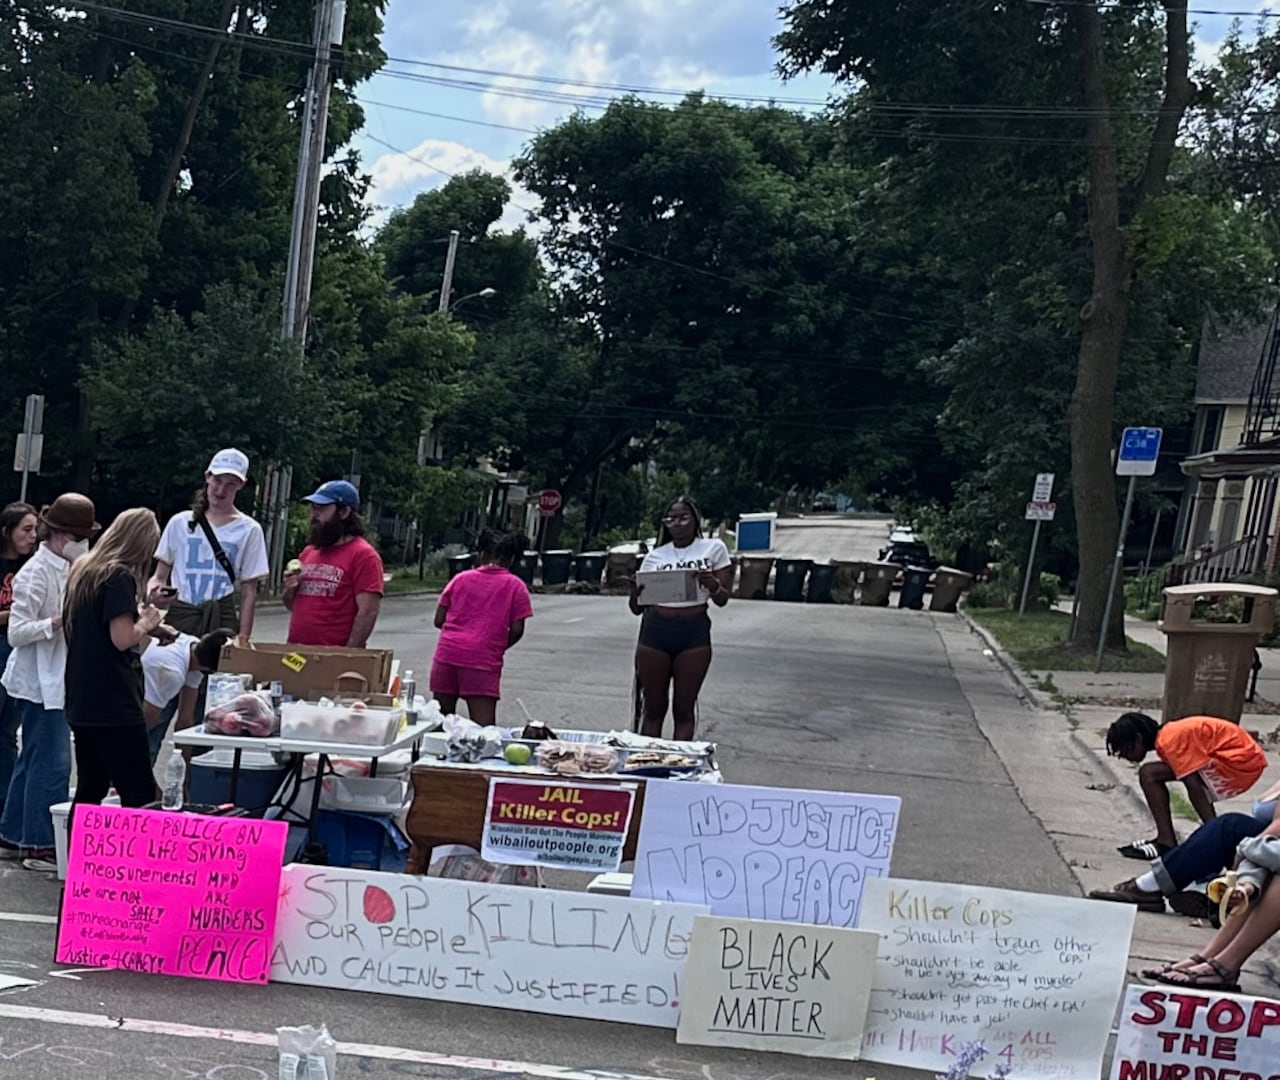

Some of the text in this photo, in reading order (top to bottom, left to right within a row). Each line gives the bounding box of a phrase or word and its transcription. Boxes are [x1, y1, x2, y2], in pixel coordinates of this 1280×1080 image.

[541, 496, 558, 506] STOP
[539, 786, 583, 804] JAIL
[499, 803, 620, 829] Killer Cops!
[689, 796, 896, 859] NO JUSTICE
[491, 836, 619, 857] wibailoutpeople.org
[72, 881, 90, 898] We
[96, 886, 116, 900] are
[296, 873, 430, 928] STOP
[647, 843, 883, 928] NO PEAC
[190, 907, 265, 931] MURDERS
[889, 889, 1014, 928] Killer Cops
[306, 920, 364, 951] OUR
[179, 934, 269, 981] PEACE!
[720, 927, 833, 980] BLACK
[341, 956, 449, 989] CALLING
[730, 971, 799, 992] LIVES
[1131, 991, 1280, 1038] STOP
[1020, 1029, 1057, 1045] ALL
[1157, 1031, 1238, 1061] THE
